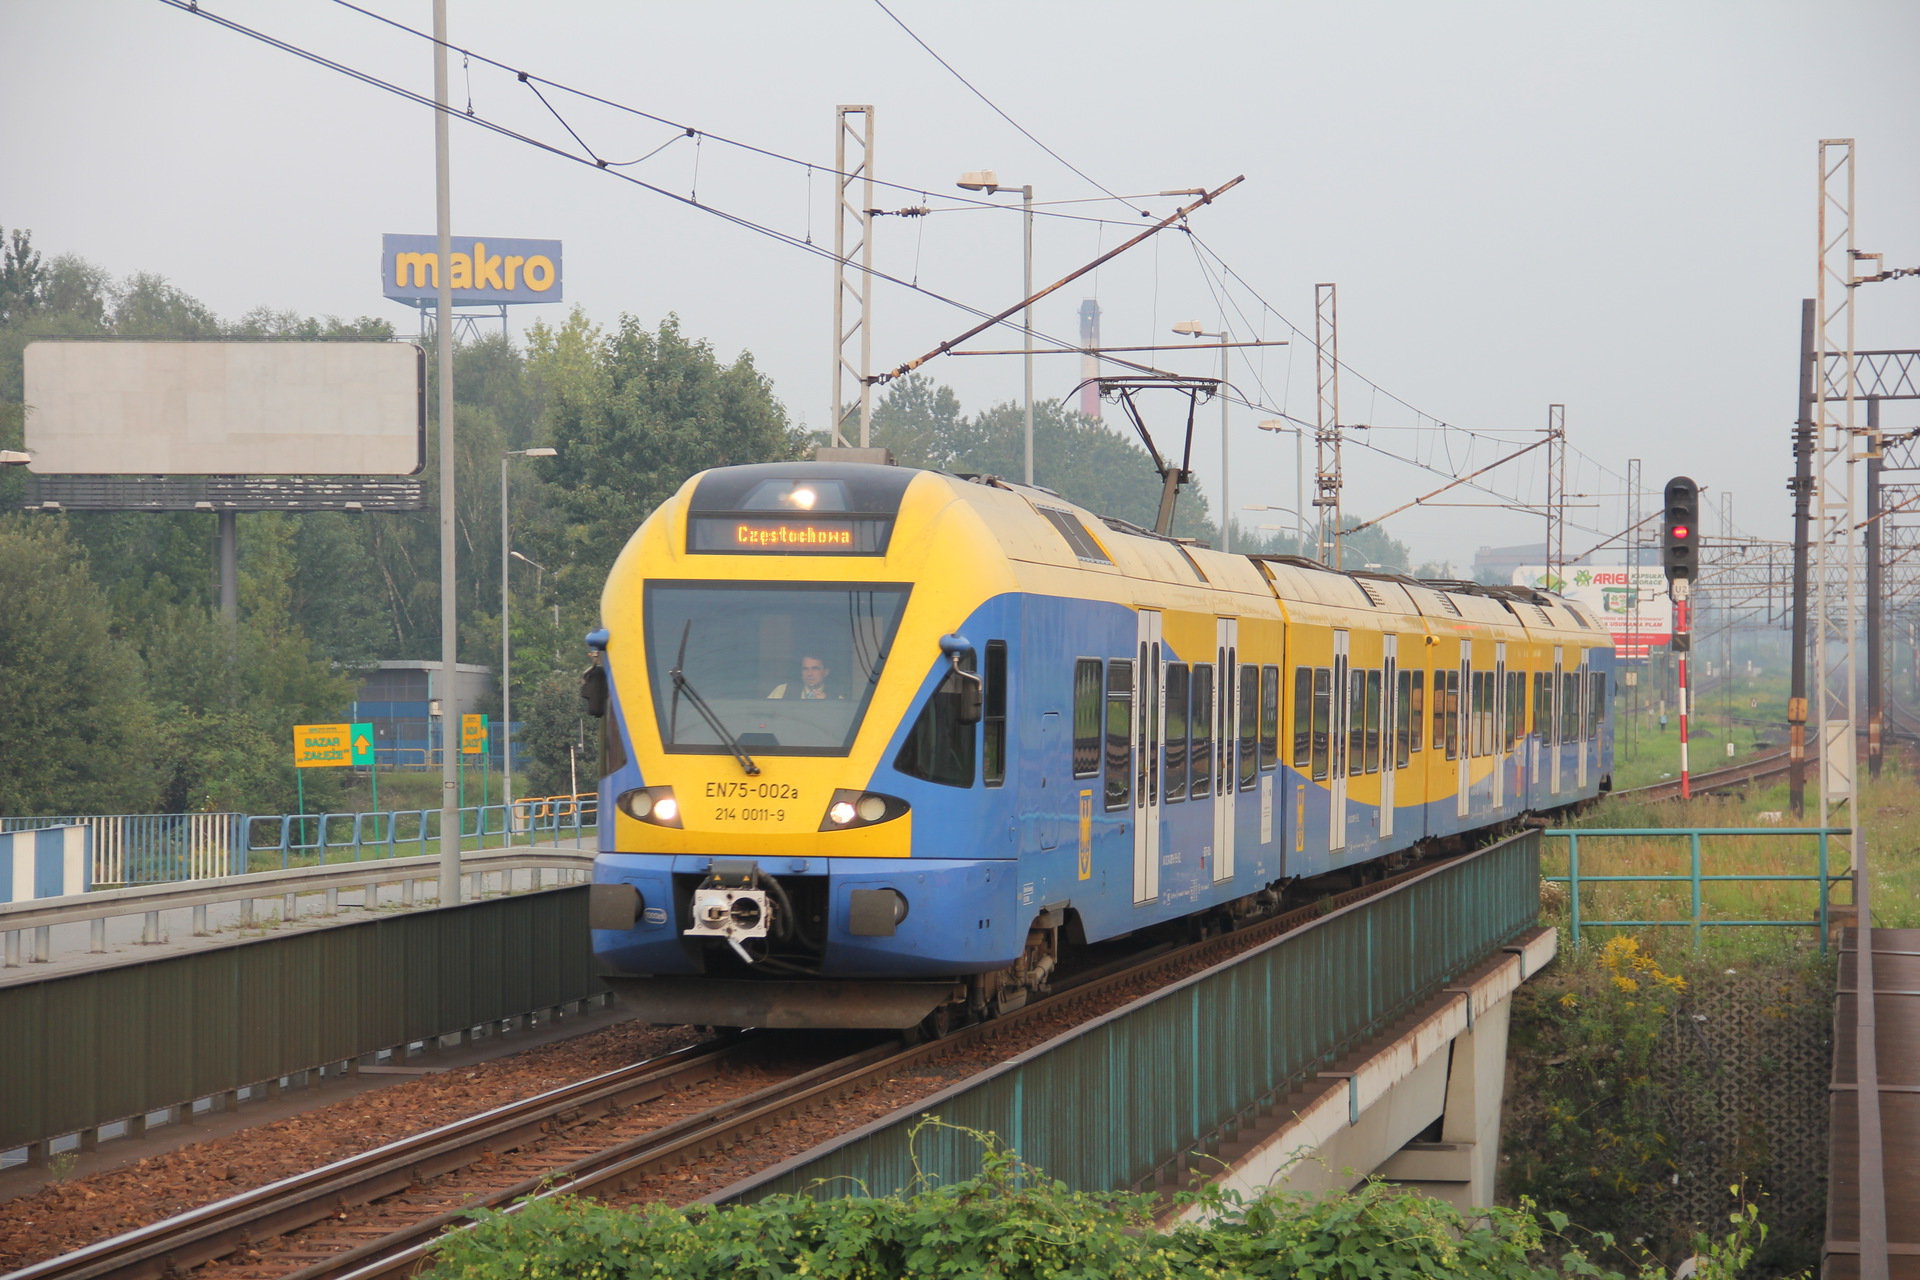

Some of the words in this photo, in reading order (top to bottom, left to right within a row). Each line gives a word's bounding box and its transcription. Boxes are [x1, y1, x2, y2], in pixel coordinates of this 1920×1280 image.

[395, 241, 556, 292] makro
[737, 525, 851, 545] Częstochowa
[1593, 573, 1630, 584] ARIEL
[304, 737, 340, 748] BAZAR
[706, 782, 799, 799] EN75-002a
[715, 808, 736, 821] 214
[742, 808, 785, 822] 0011-9
